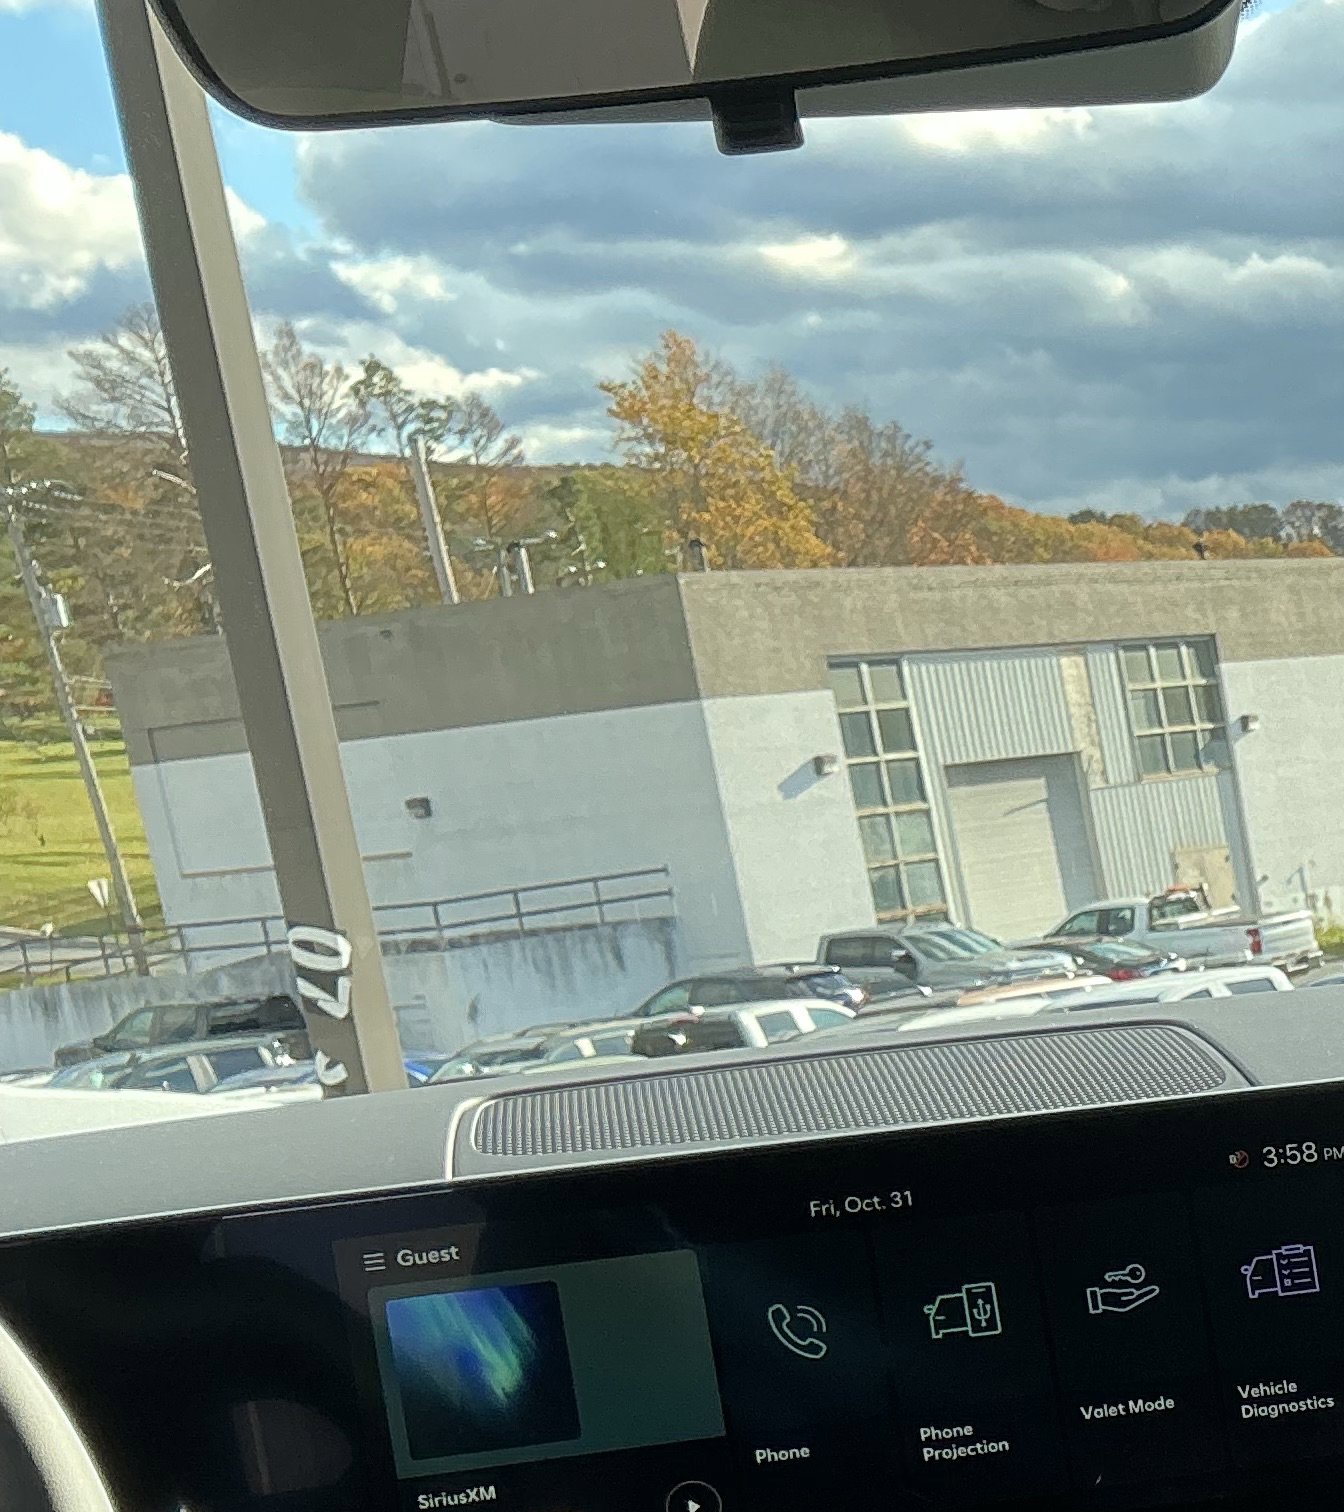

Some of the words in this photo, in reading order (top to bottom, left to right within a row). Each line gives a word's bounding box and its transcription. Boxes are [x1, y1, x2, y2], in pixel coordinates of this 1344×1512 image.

[1262, 1141, 1319, 1168] 3:58
[809, 1197, 841, 1218] Fri,
[844, 1193, 887, 1214] Oct.
[890, 1190, 913, 1209] 31
[396, 1244, 460, 1268] Guest
[1237, 1379, 1298, 1399] Vehicle
[1080, 1402, 1126, 1421] Valet
[1128, 1395, 1176, 1415] Mode
[1241, 1394, 1336, 1419] Diagnostics
[919, 1422, 974, 1442] Phone
[755, 1444, 811, 1465] Phone
[922, 1437, 1010, 1463] Projection
[417, 1485, 497, 1512] SiriusXM
